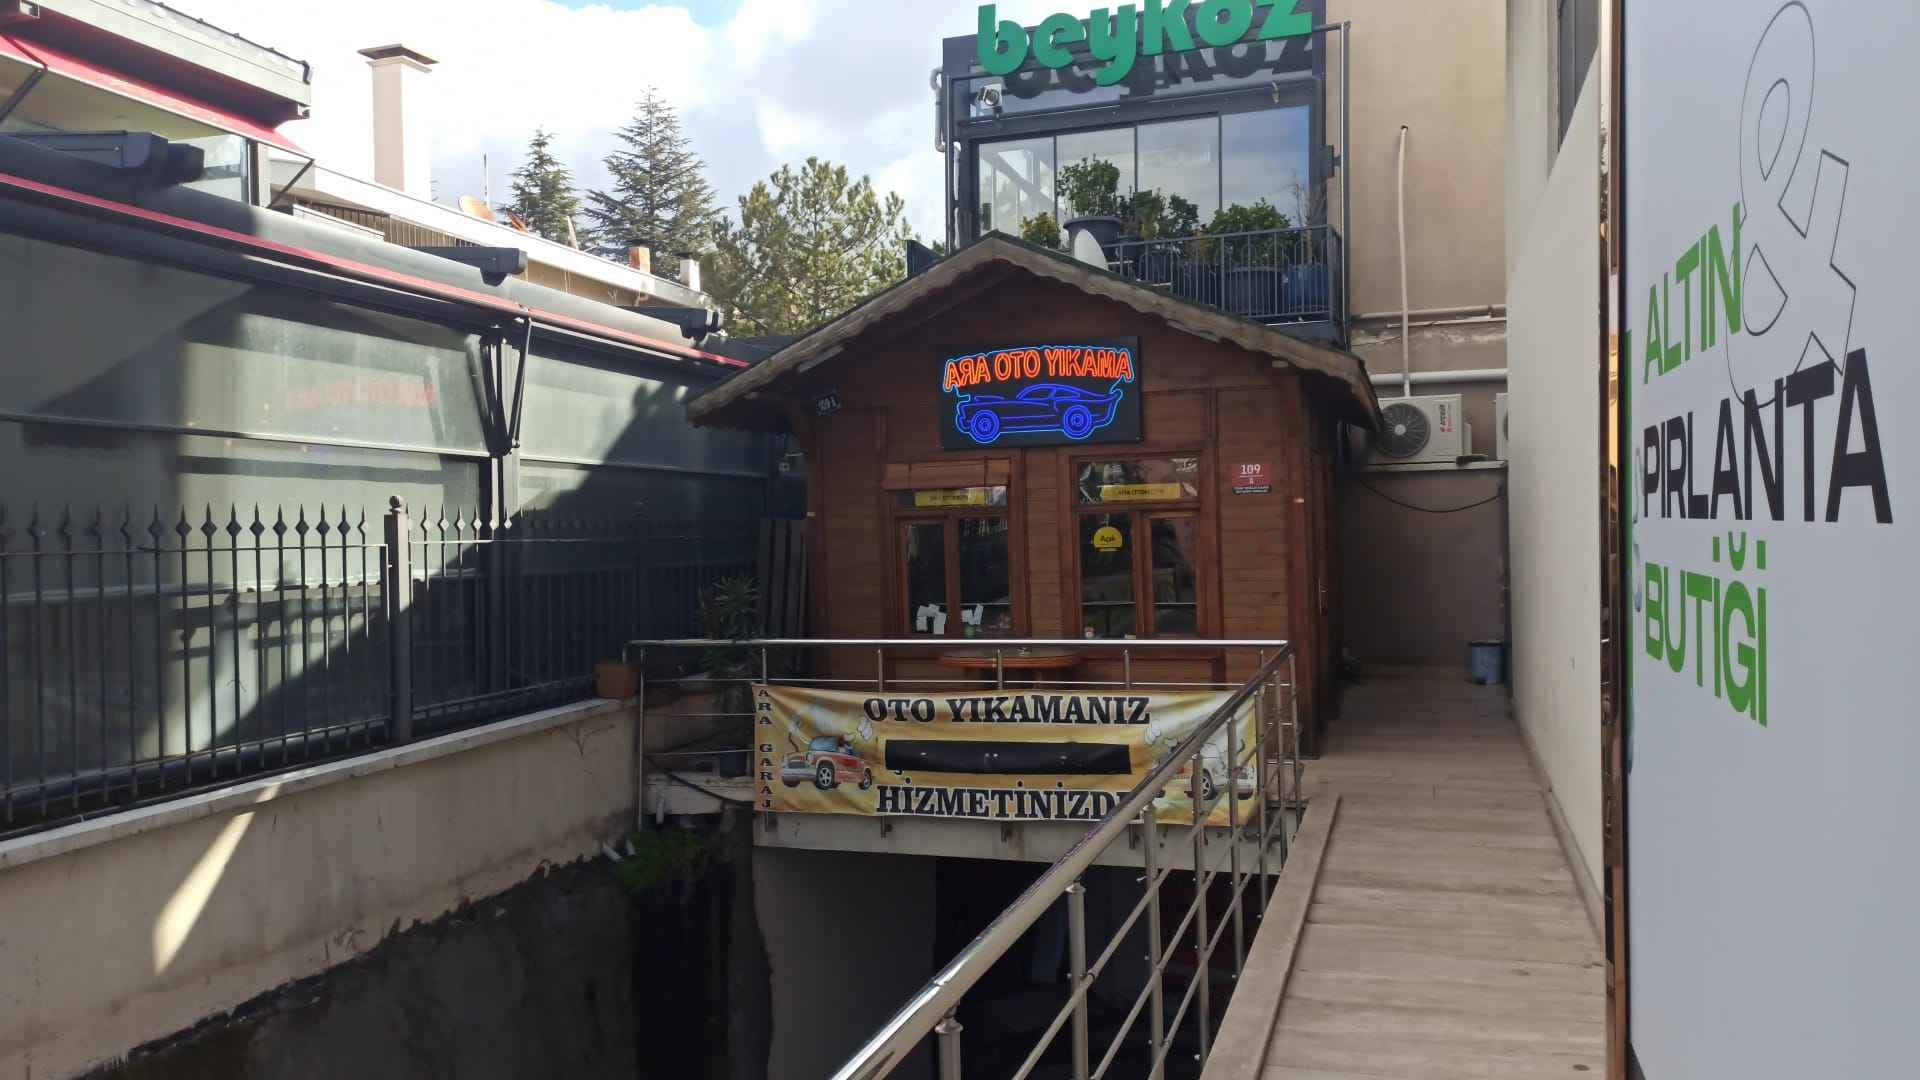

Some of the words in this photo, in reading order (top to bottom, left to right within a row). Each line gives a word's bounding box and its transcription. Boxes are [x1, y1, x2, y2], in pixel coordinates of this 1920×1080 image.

[978, 0, 1313, 86] beykoz
[1643, 201, 1742, 386] ALTIN
[994, 349, 1041, 382] OTO
[1044, 348, 1133, 383] YIKAMA
[1643, 347, 1894, 525] PIRLANTA
[1240, 463, 1261, 475] 109
[1643, 531, 1769, 728] BUTİĞİ
[757, 688, 773, 725] ARA
[863, 697, 936, 723] OTO
[948, 694, 1151, 725] YIKAMANIZ
[759, 743, 773, 808] GARAJ
